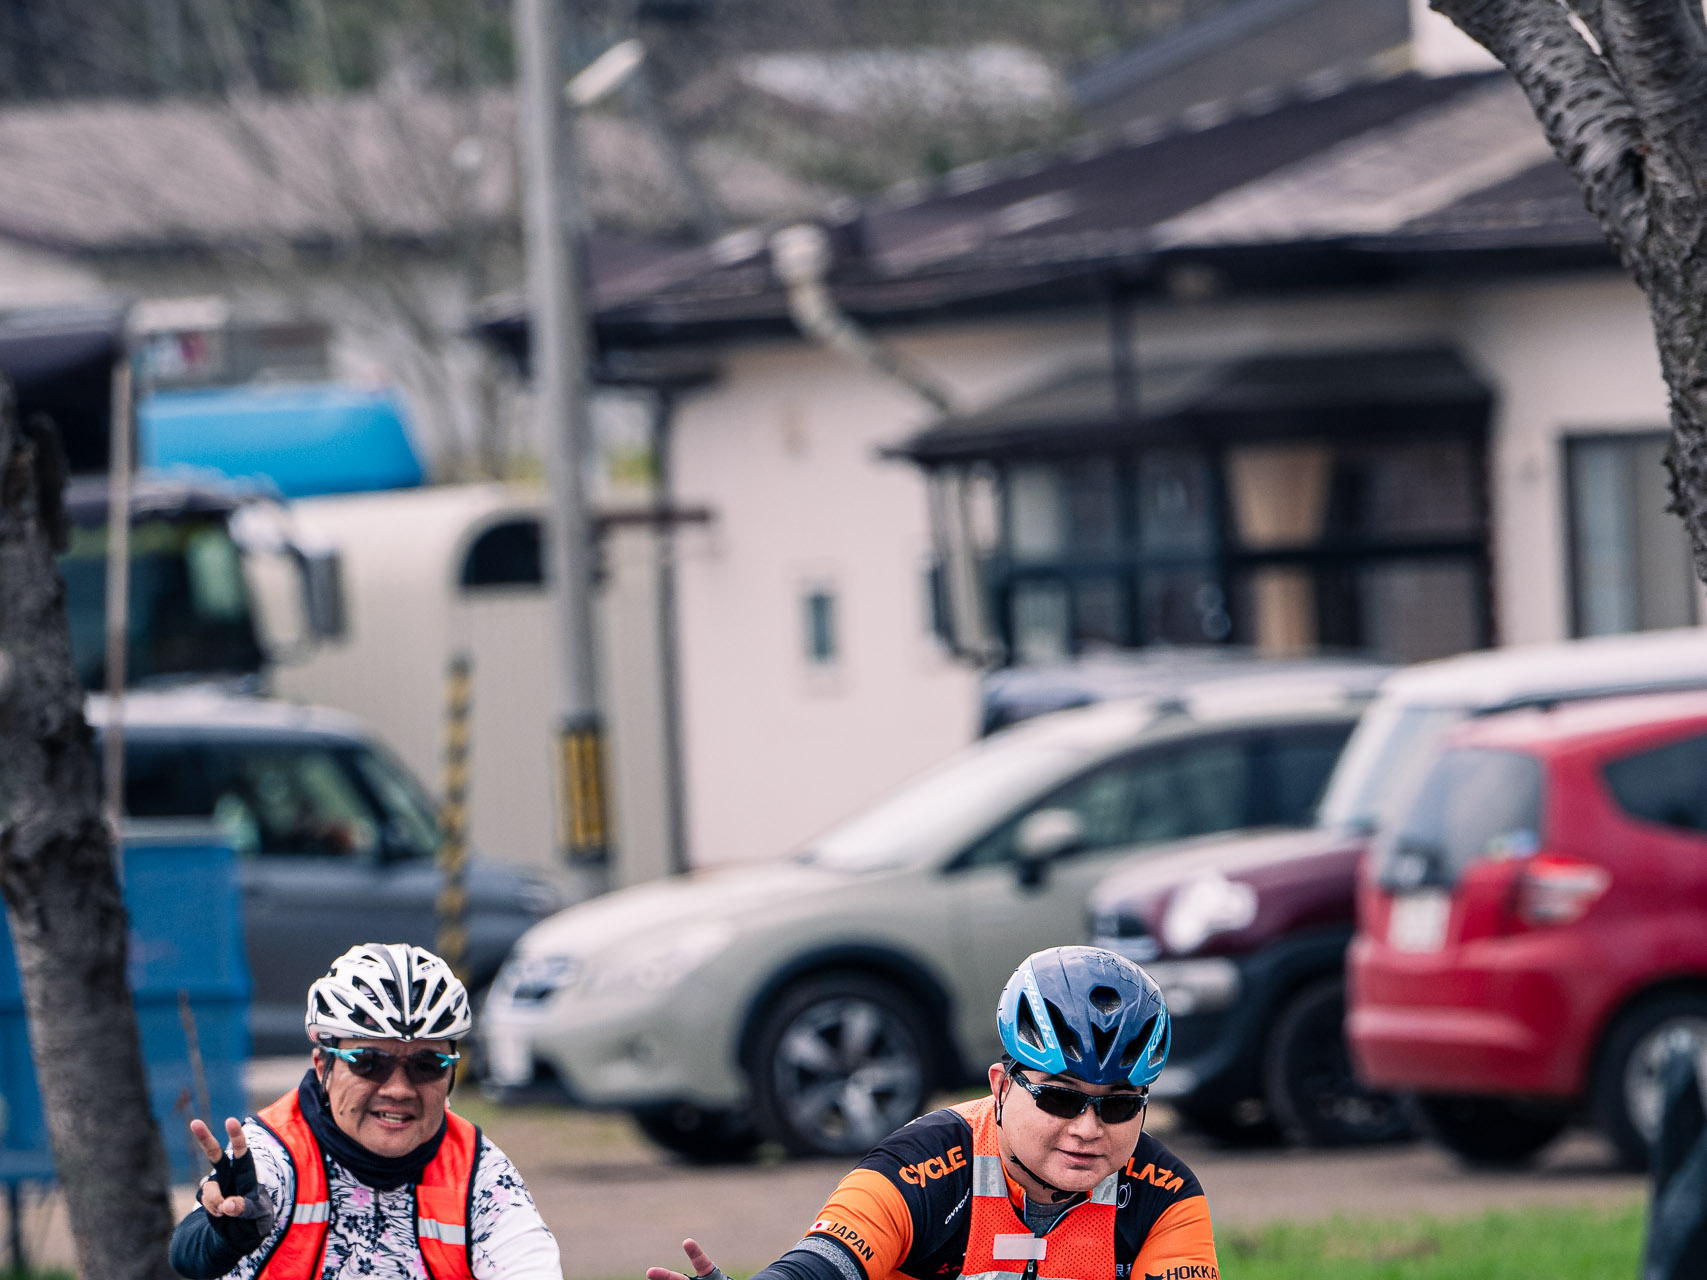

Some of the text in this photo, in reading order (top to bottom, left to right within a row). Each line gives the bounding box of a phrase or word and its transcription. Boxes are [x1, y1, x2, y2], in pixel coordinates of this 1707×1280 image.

[898, 1145, 1185, 1194] CYCLE LAZA
[827, 1222, 875, 1262] JAPAN
